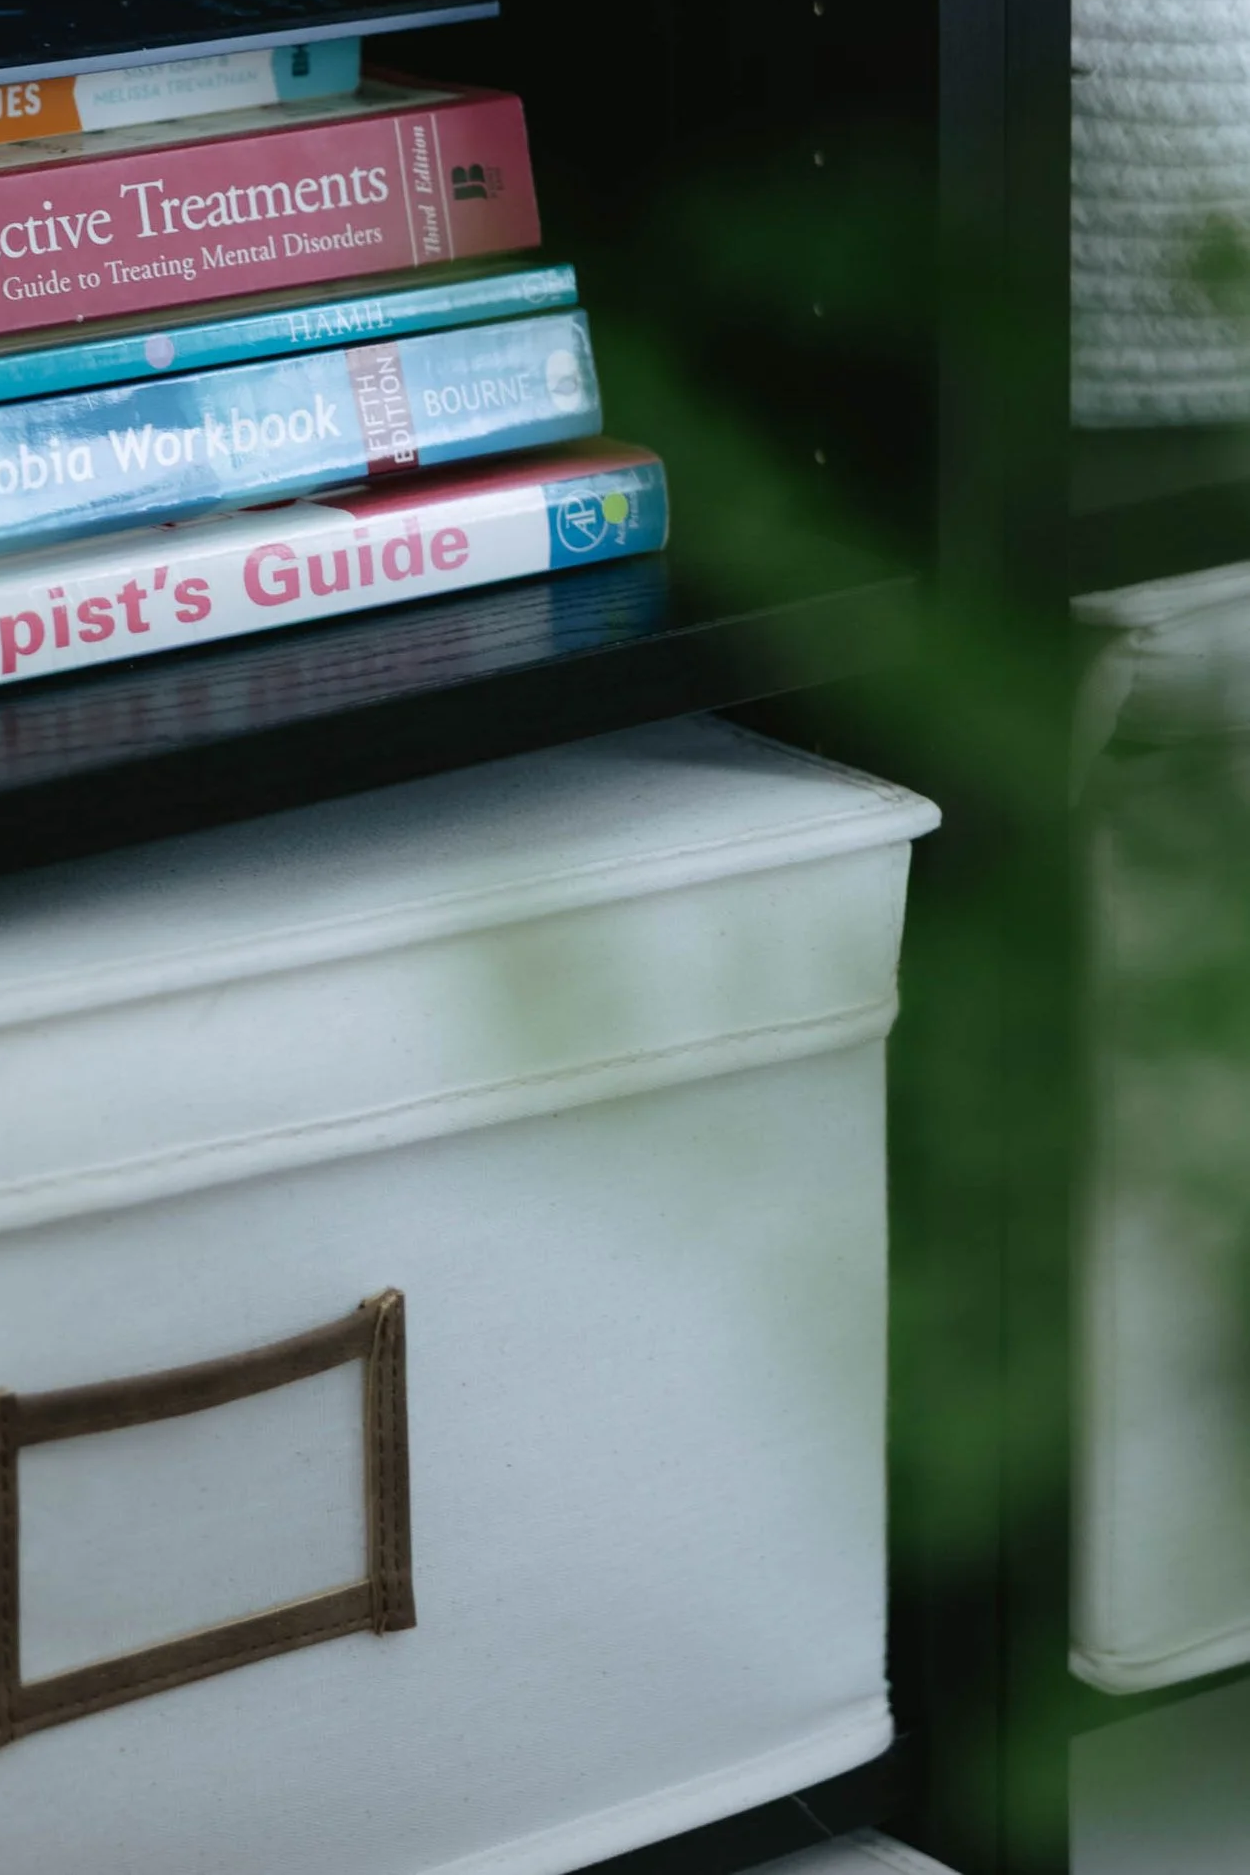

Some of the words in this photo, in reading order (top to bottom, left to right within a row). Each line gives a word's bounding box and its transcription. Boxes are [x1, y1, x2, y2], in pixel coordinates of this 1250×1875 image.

[120, 162, 388, 238] Treatments
[412, 125, 433, 195] Edition
[3, 273, 72, 303] Guide
[78, 270, 101, 290] to
[104, 253, 197, 288] Treating
[201, 237, 276, 270] Mental
[282, 223, 383, 260] Disorders
[286, 300, 394, 343] HAMIL
[107, 393, 342, 477] Workbook
[357, 374, 389, 457] FIFTH
[375, 355, 415, 465] EDITION
[423, 375, 534, 417] BOURNE
[241, 516, 470, 608] Guide
